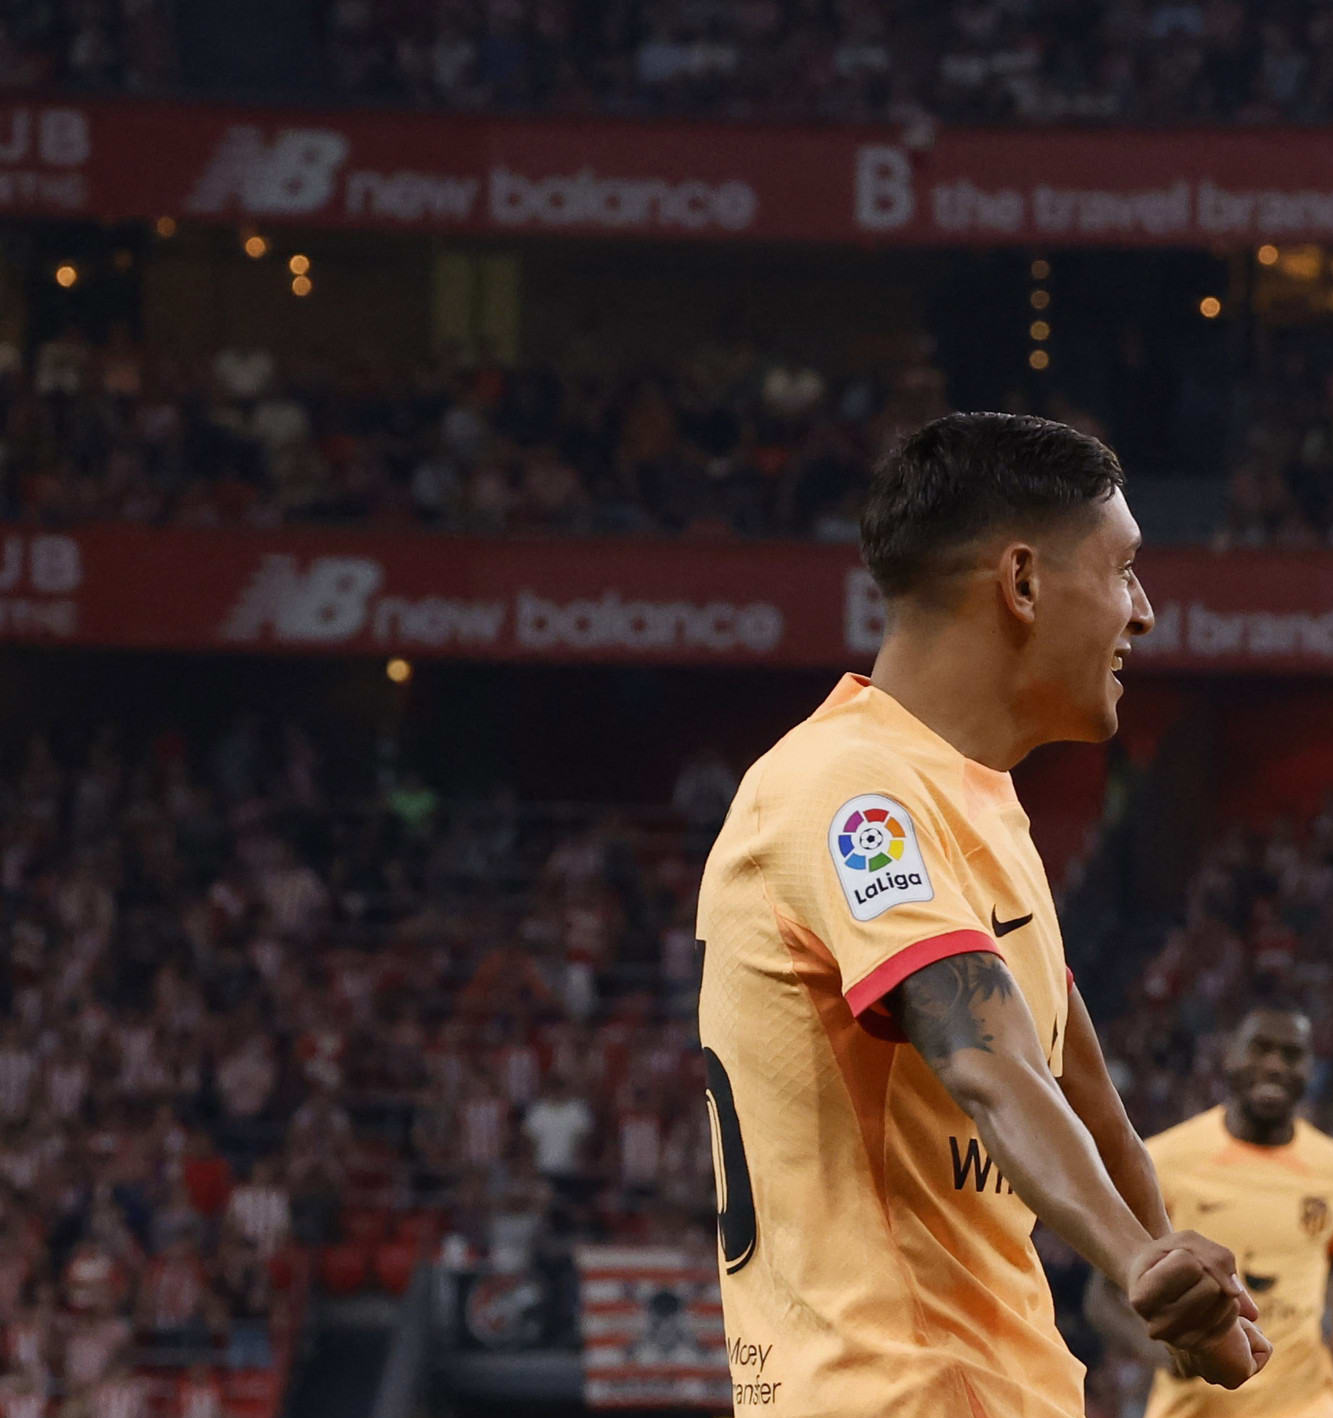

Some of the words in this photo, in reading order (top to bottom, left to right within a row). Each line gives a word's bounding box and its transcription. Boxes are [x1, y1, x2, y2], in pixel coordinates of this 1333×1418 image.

[345, 170, 480, 220] new
[489, 164, 758, 228] balance
[930, 179, 1023, 231] the
[1033, 177, 1190, 233] travel
[373, 596, 503, 645] new
[515, 590, 784, 652] balance
[854, 872, 922, 904] LaLiga
